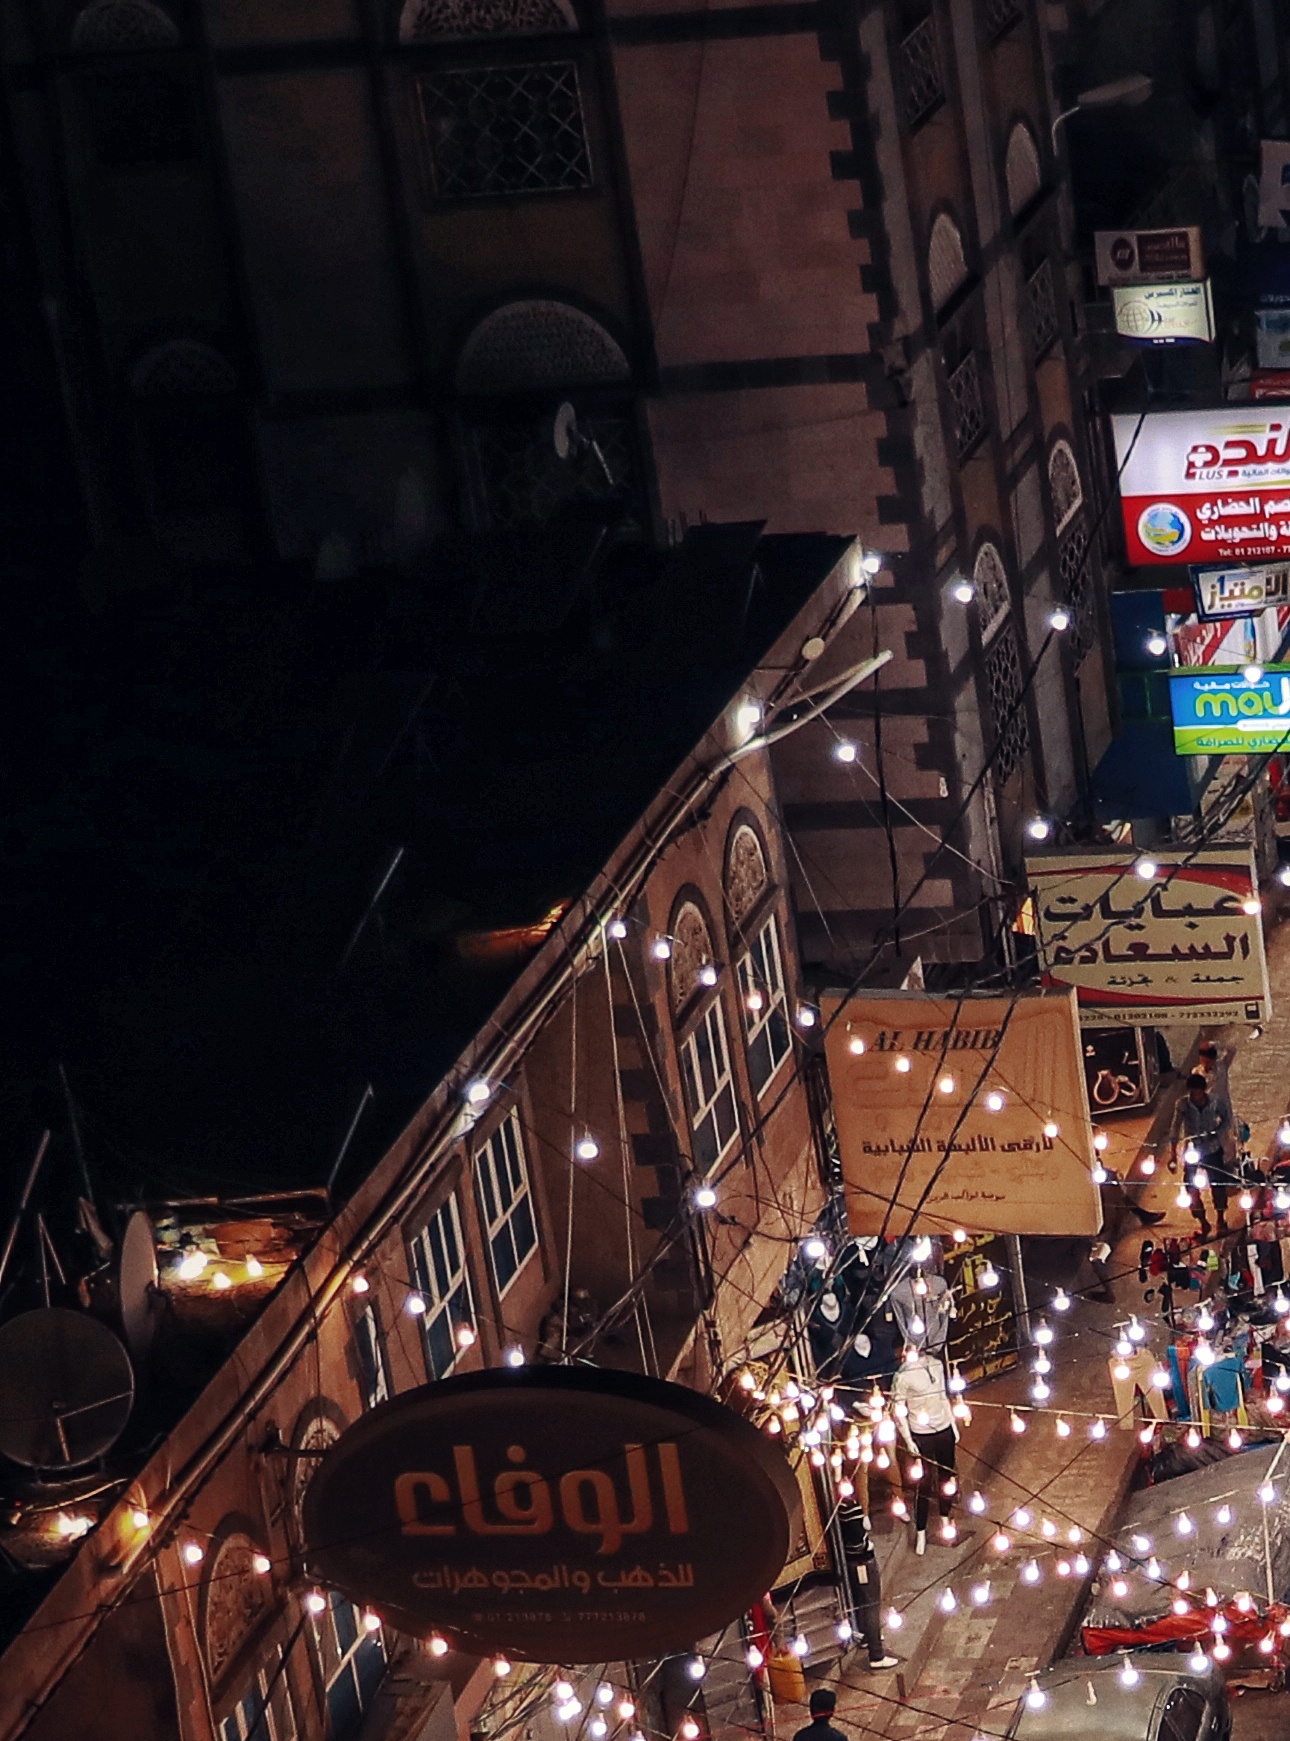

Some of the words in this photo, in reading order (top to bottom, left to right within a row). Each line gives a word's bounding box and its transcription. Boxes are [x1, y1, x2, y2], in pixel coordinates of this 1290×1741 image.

[1195, 496, 1261, 524] الحضاري
[1200, 521, 1278, 543] والتحويلات
[1044, 888, 1246, 931] عبايات
[1052, 931, 1250, 966] السعادة
[1190, 974, 1245, 985] جملة
[868, 1030, 905, 1052] AL
[912, 1029, 1001, 1051] HABIB
[394, 1442, 690, 1555] الوفاء
[412, 1562, 592, 1596] والمجوهرات
[598, 1562, 695, 1590] للذهب
